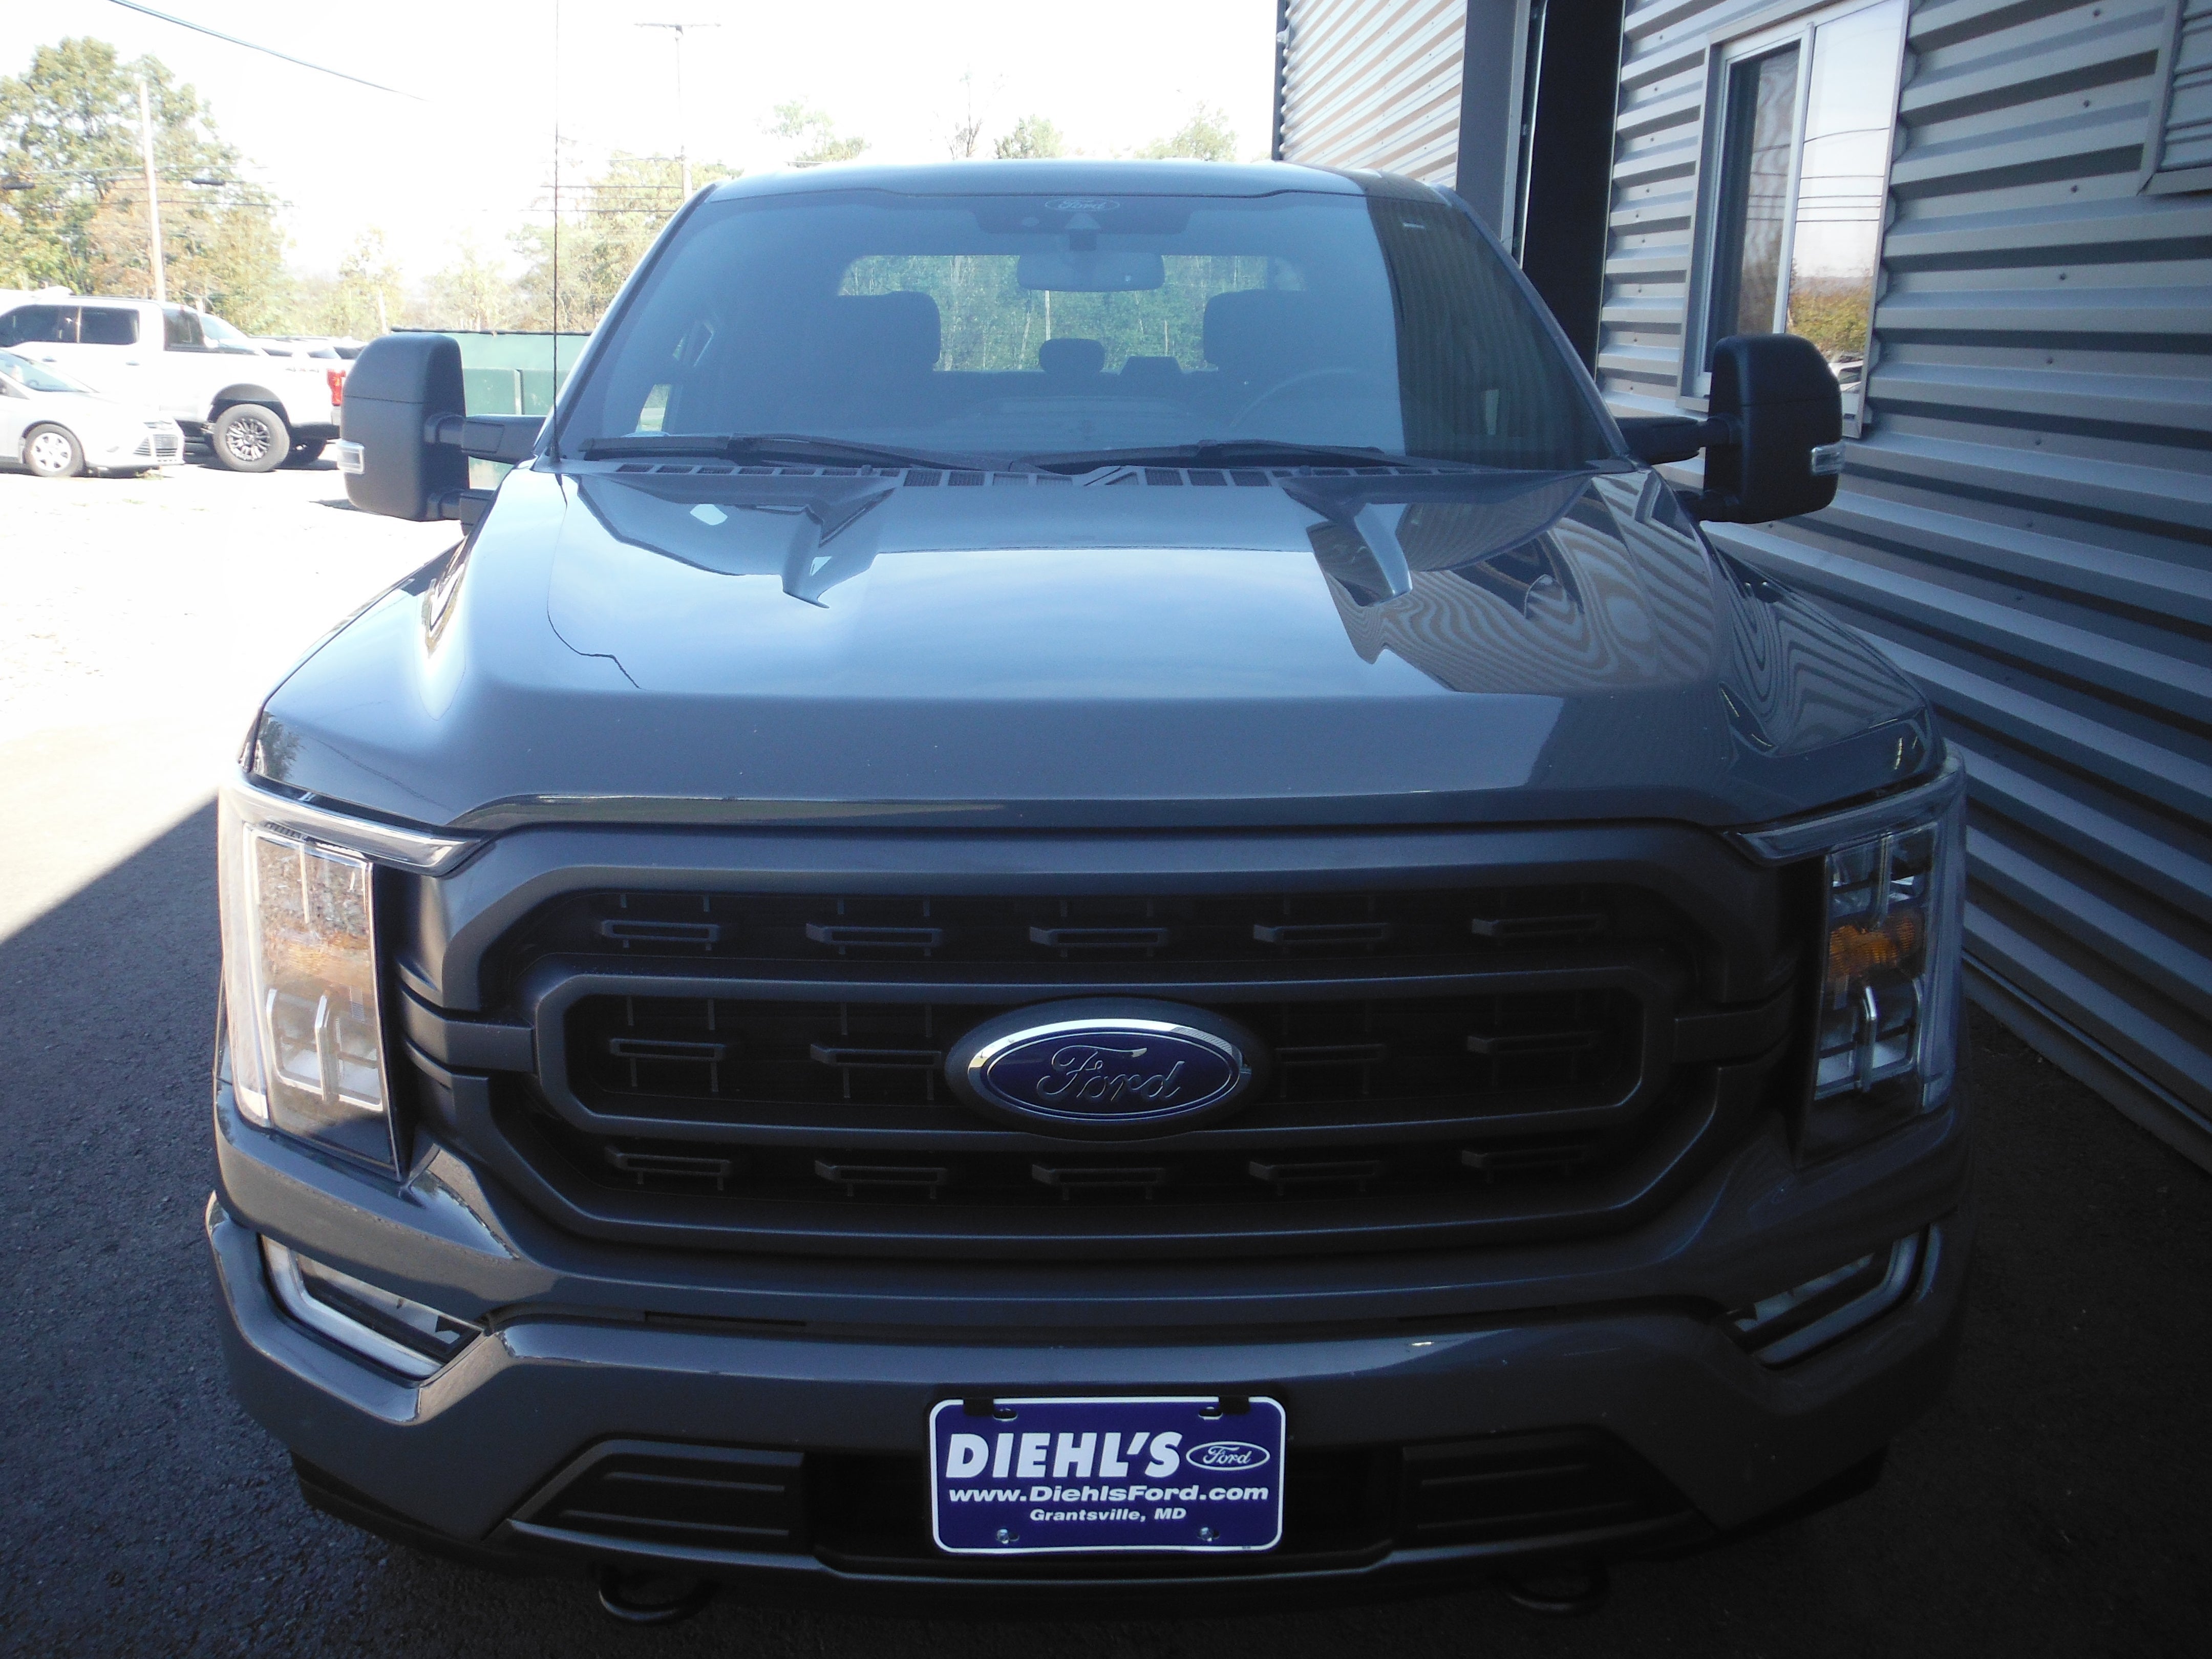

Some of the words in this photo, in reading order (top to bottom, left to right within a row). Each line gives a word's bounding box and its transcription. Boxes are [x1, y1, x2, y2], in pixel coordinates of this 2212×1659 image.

[1037, 1045, 1185, 1102] Ford
[946, 1432, 1183, 1478] DIEHL'S
[1202, 1445, 1251, 1466] Ford
[949, 1485, 1269, 1502] www.DiehlsFord.com
[1030, 1508, 1146, 1522] Grantsville,
[1154, 1507, 1187, 1520] MD
